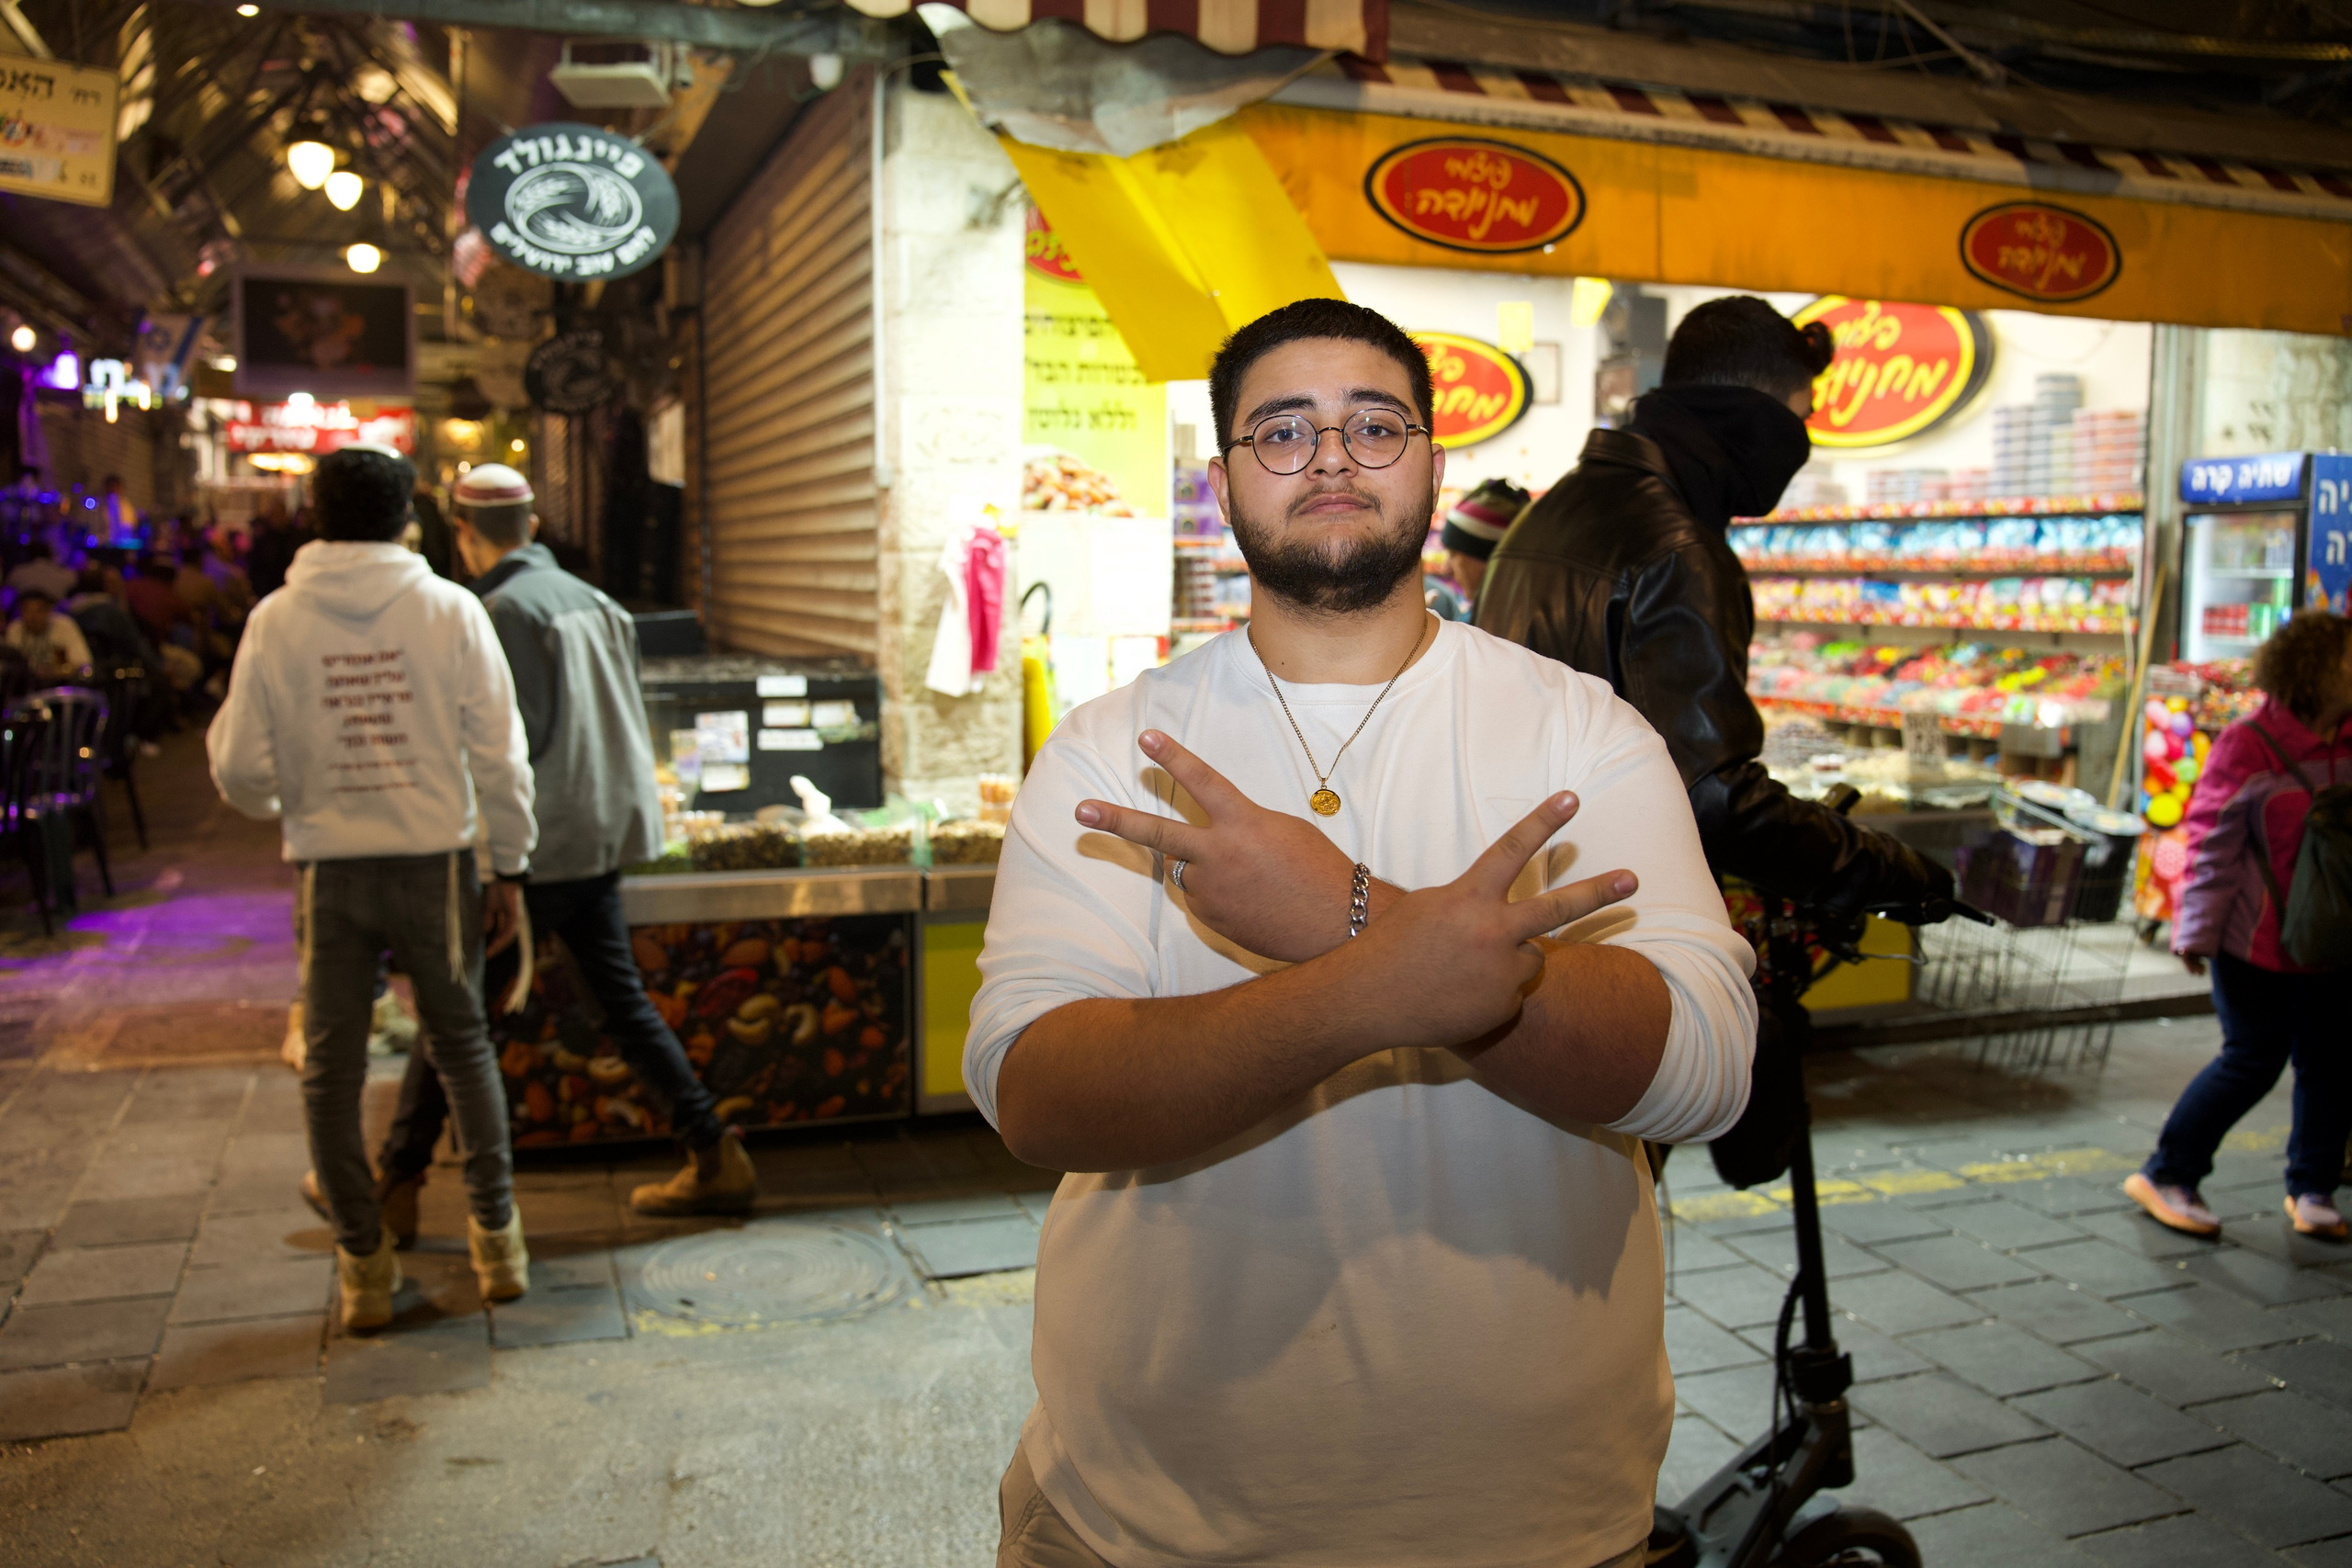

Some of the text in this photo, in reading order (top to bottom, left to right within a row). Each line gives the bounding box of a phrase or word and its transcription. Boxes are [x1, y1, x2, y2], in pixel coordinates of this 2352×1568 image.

[493, 133, 645, 180] פיינגולד
[2191, 463, 2292, 497] שתיה קרה
[2318, 479, 2352, 515] יה
